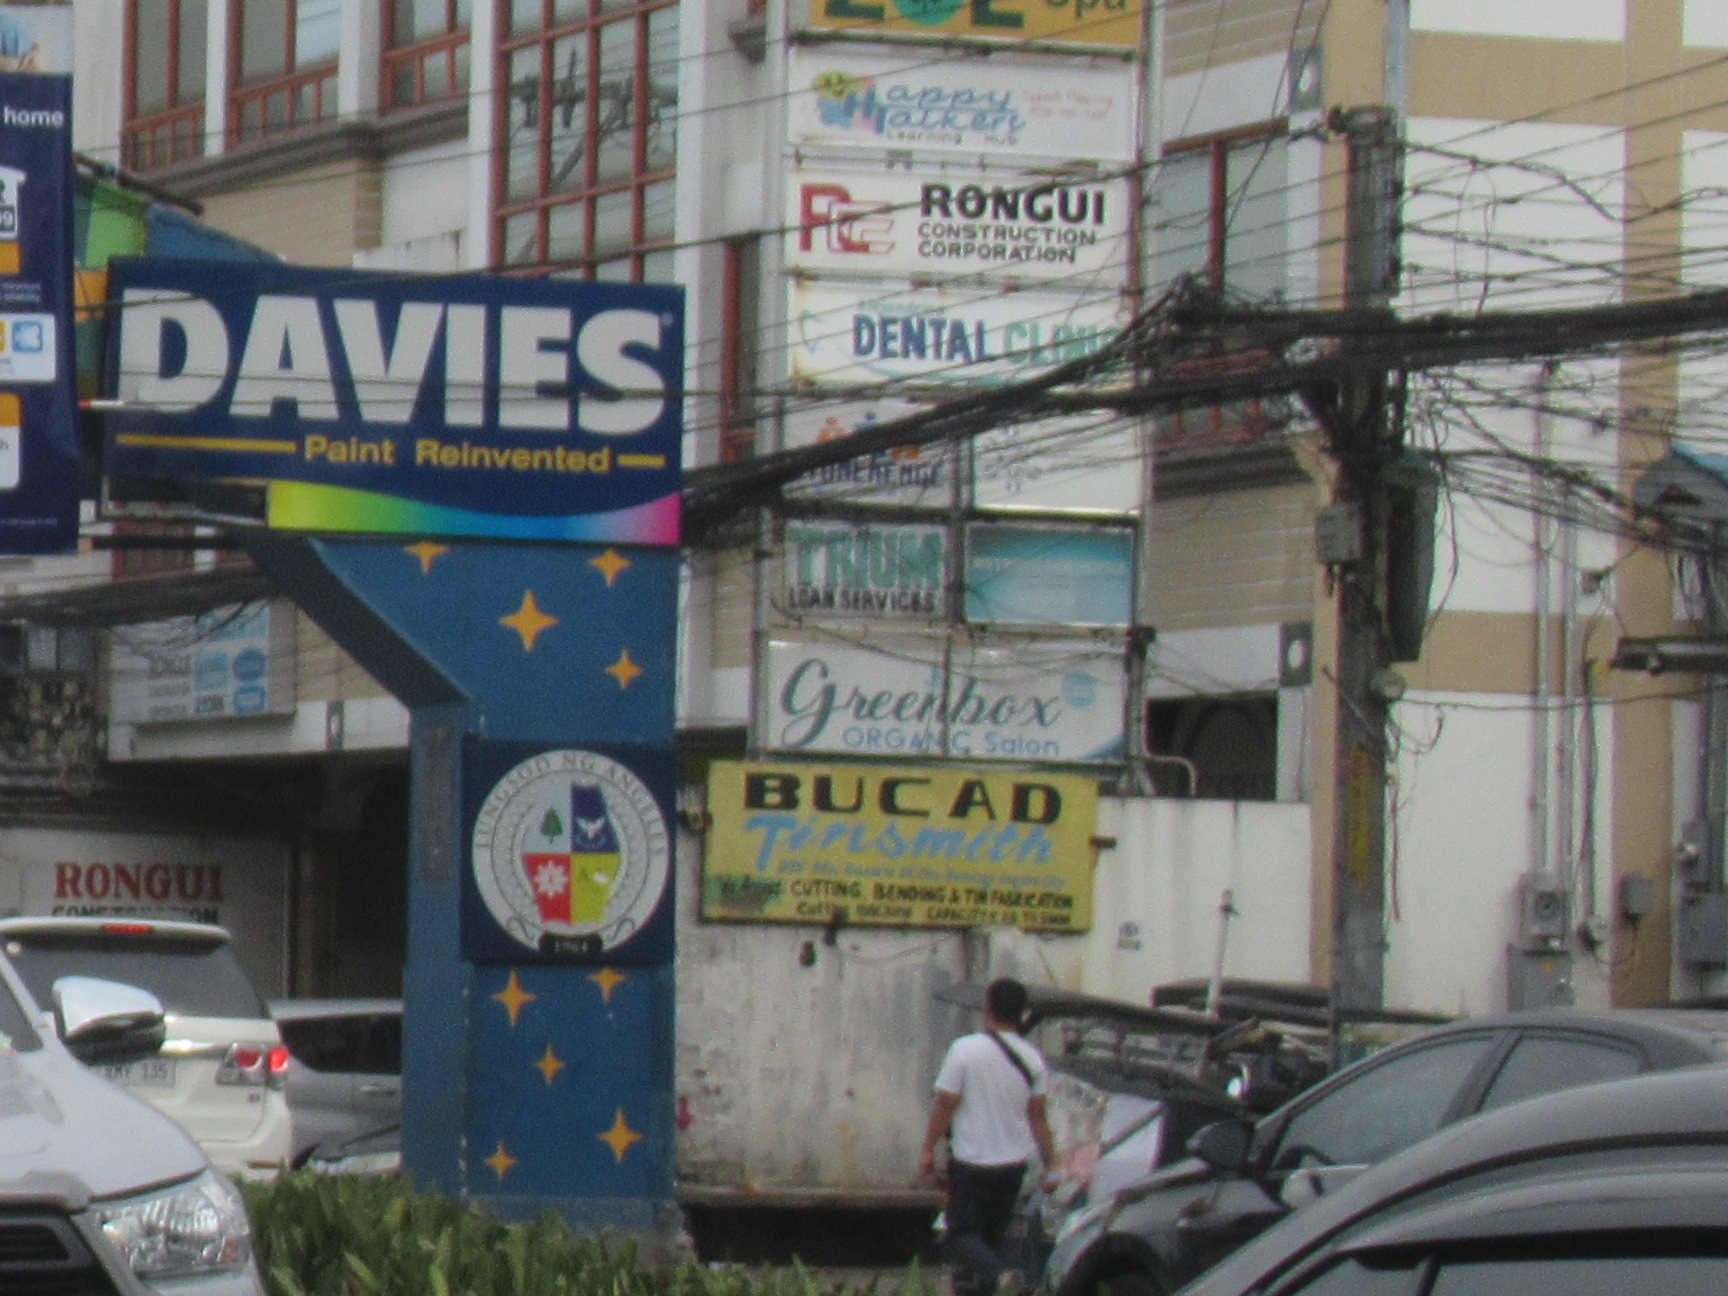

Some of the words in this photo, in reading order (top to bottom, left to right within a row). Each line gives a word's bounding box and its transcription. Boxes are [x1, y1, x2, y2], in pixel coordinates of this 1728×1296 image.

[4, 104, 65, 127] home
[919, 182, 1106, 225] RONGUI
[917, 221, 1097, 246] CONSTRUCTION
[918, 240, 1077, 264] CORPORATION
[852, 313, 986, 364] DENTAL
[121, 287, 666, 436] DAVIES
[304, 435, 396, 466] Paint
[415, 439, 611, 474] Reinvented
[842, 725, 971, 755] ORGANC
[983, 729, 1061, 756] Salon
[744, 772, 1064, 825] BUCAD
[744, 810, 1055, 874] Tinsmith
[54, 861, 224, 902] RONGUI
